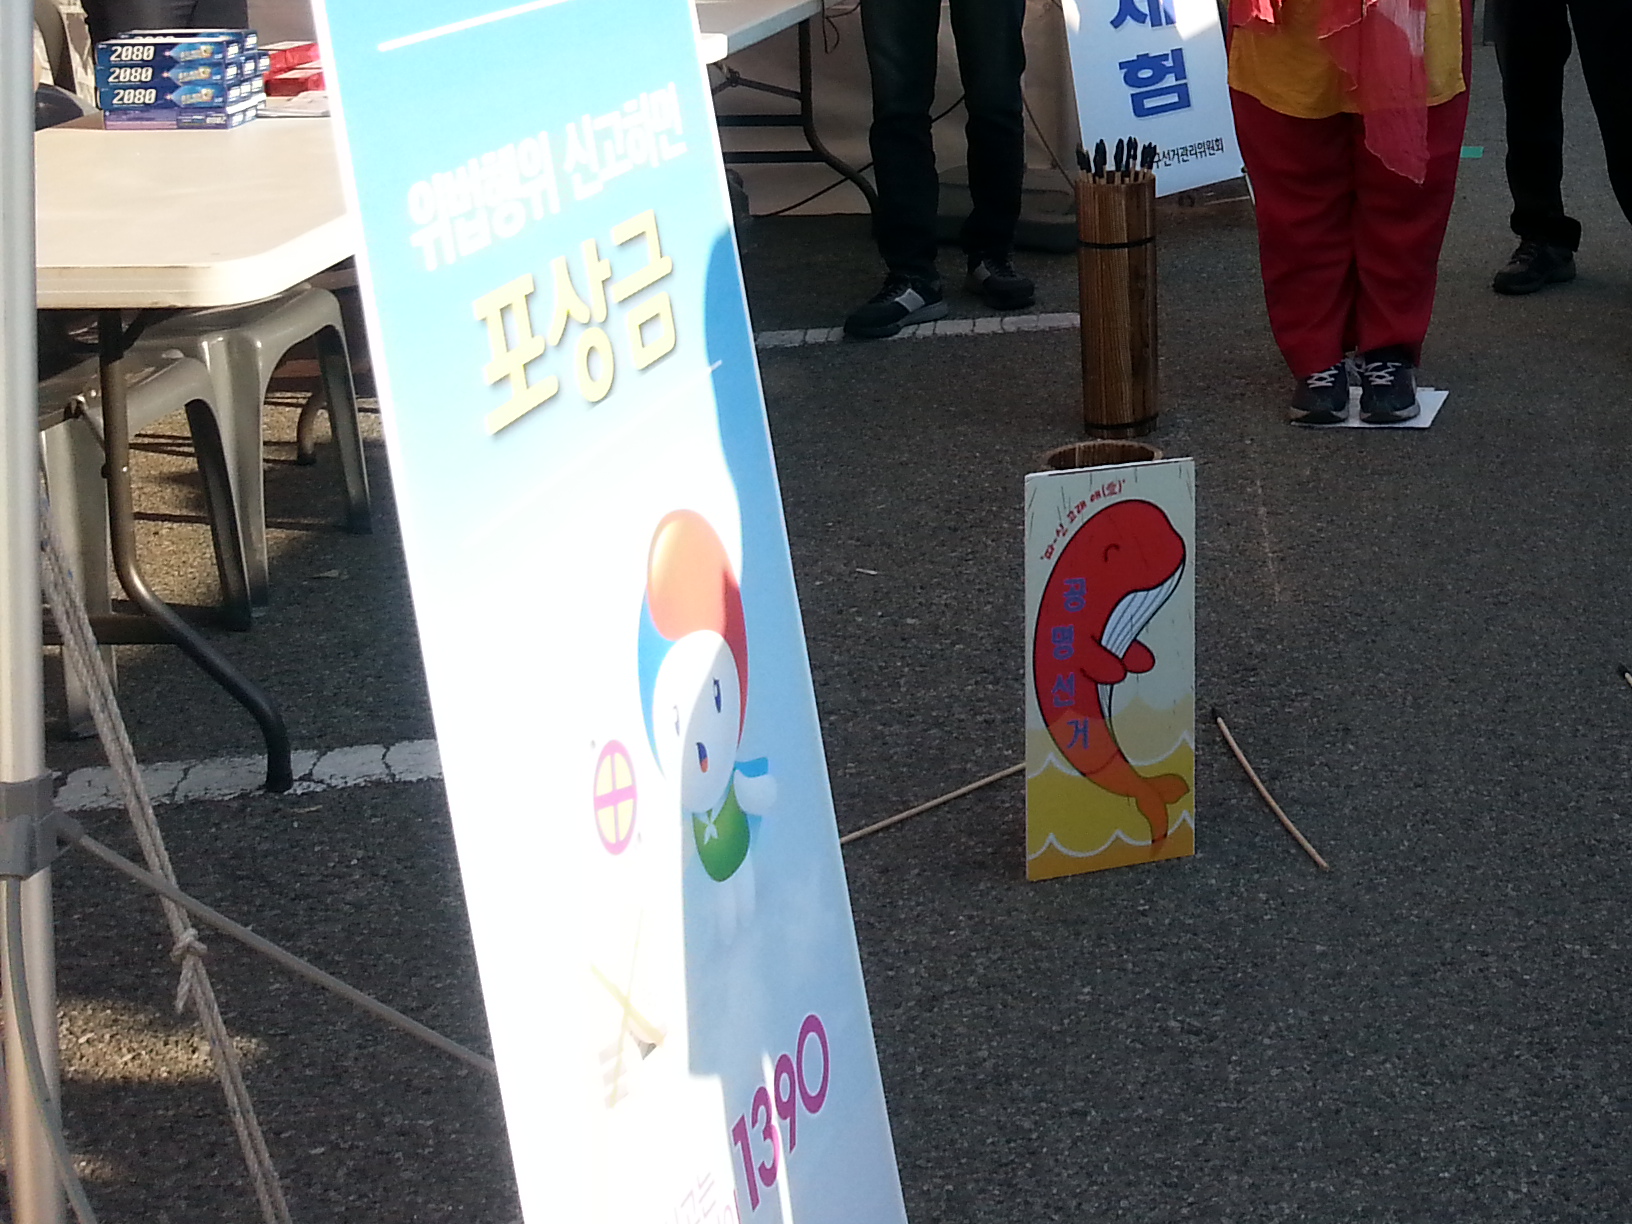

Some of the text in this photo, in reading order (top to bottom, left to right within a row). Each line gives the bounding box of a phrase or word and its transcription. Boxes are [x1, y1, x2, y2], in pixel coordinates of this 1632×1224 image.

[107, 66, 153, 83] 2080
[109, 45, 155, 61] 2080
[112, 88, 157, 105] 2080
[563, 81, 688, 202] 신고하면
[473, 208, 678, 436] 포상금
[731, 1013, 830, 1213] 1390
